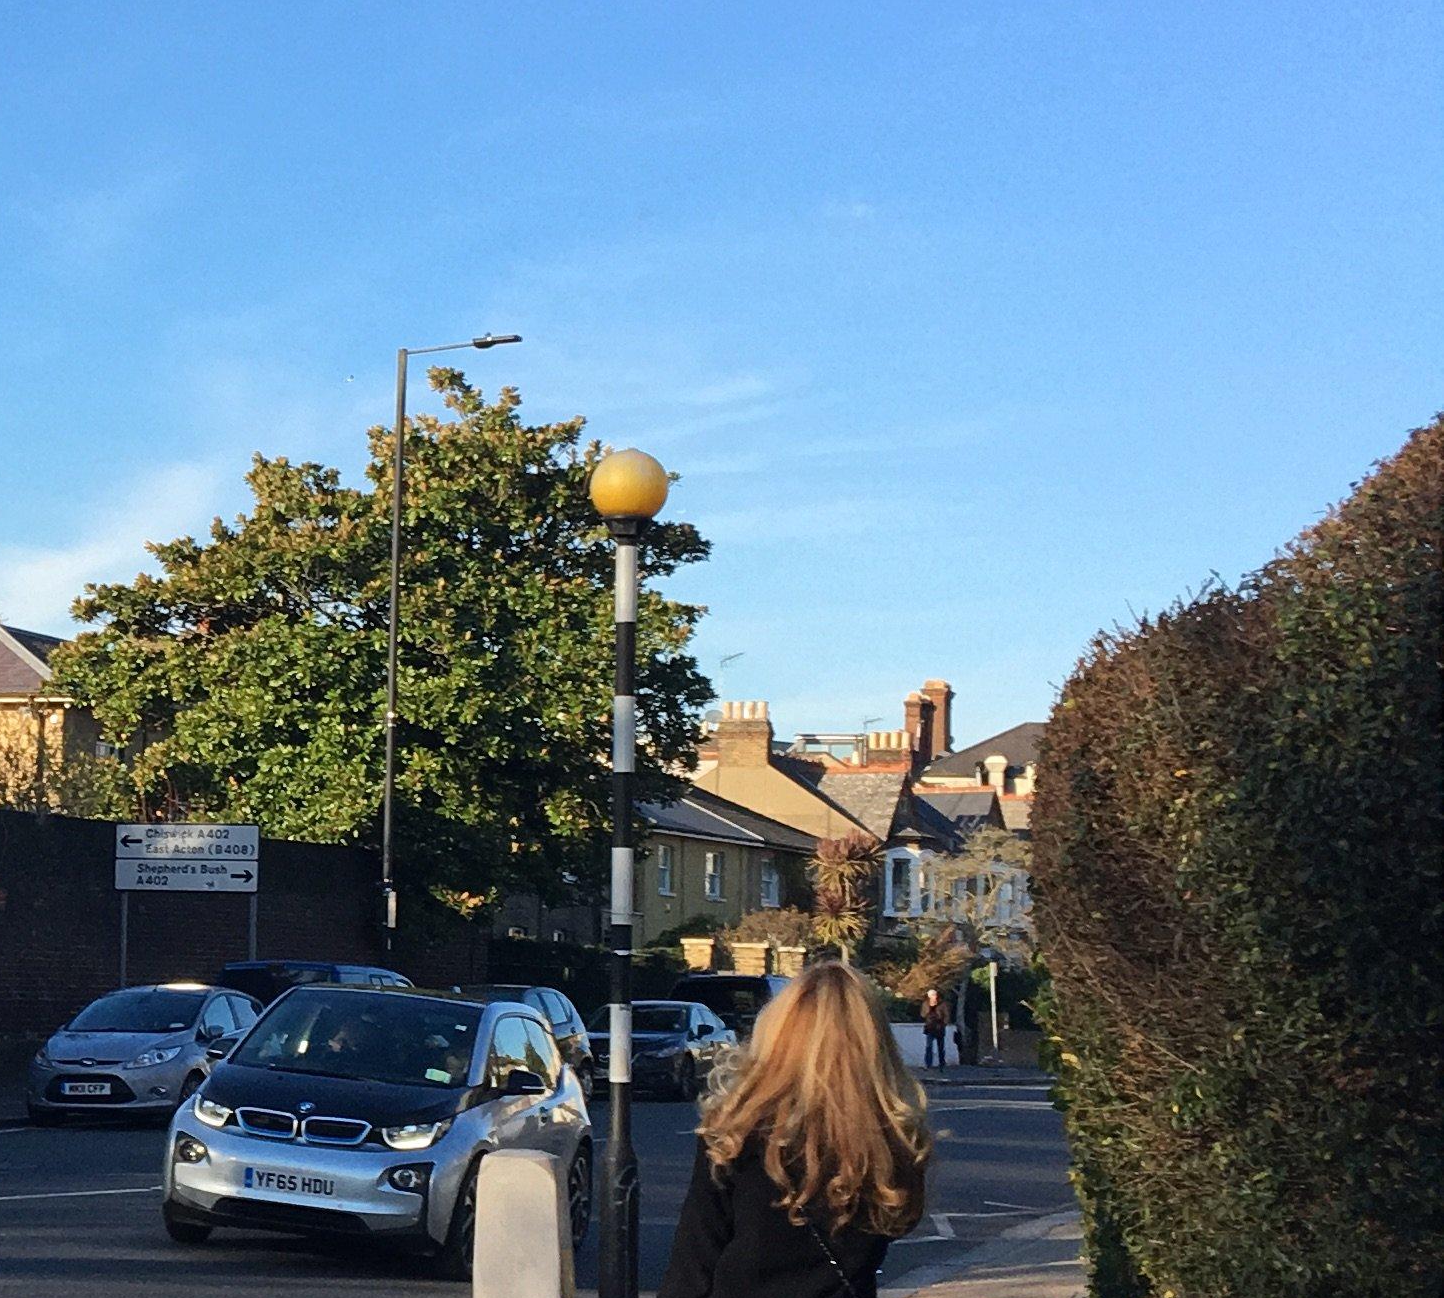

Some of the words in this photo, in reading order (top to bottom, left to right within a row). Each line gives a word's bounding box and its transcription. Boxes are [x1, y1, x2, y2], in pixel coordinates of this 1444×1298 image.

[146, 828, 193, 840] Chiswick
[197, 828, 230, 840] A402
[146, 843, 169, 854] East
[172, 844, 205, 855] Acton
[207, 844, 256, 856] (B408)
[136, 863, 197, 875] Shepherd's
[200, 864, 228, 875] Bush
[136, 875, 169, 886] A402
[255, 1170, 298, 1191] YF65
[301, 1176, 335, 1195] HDU
